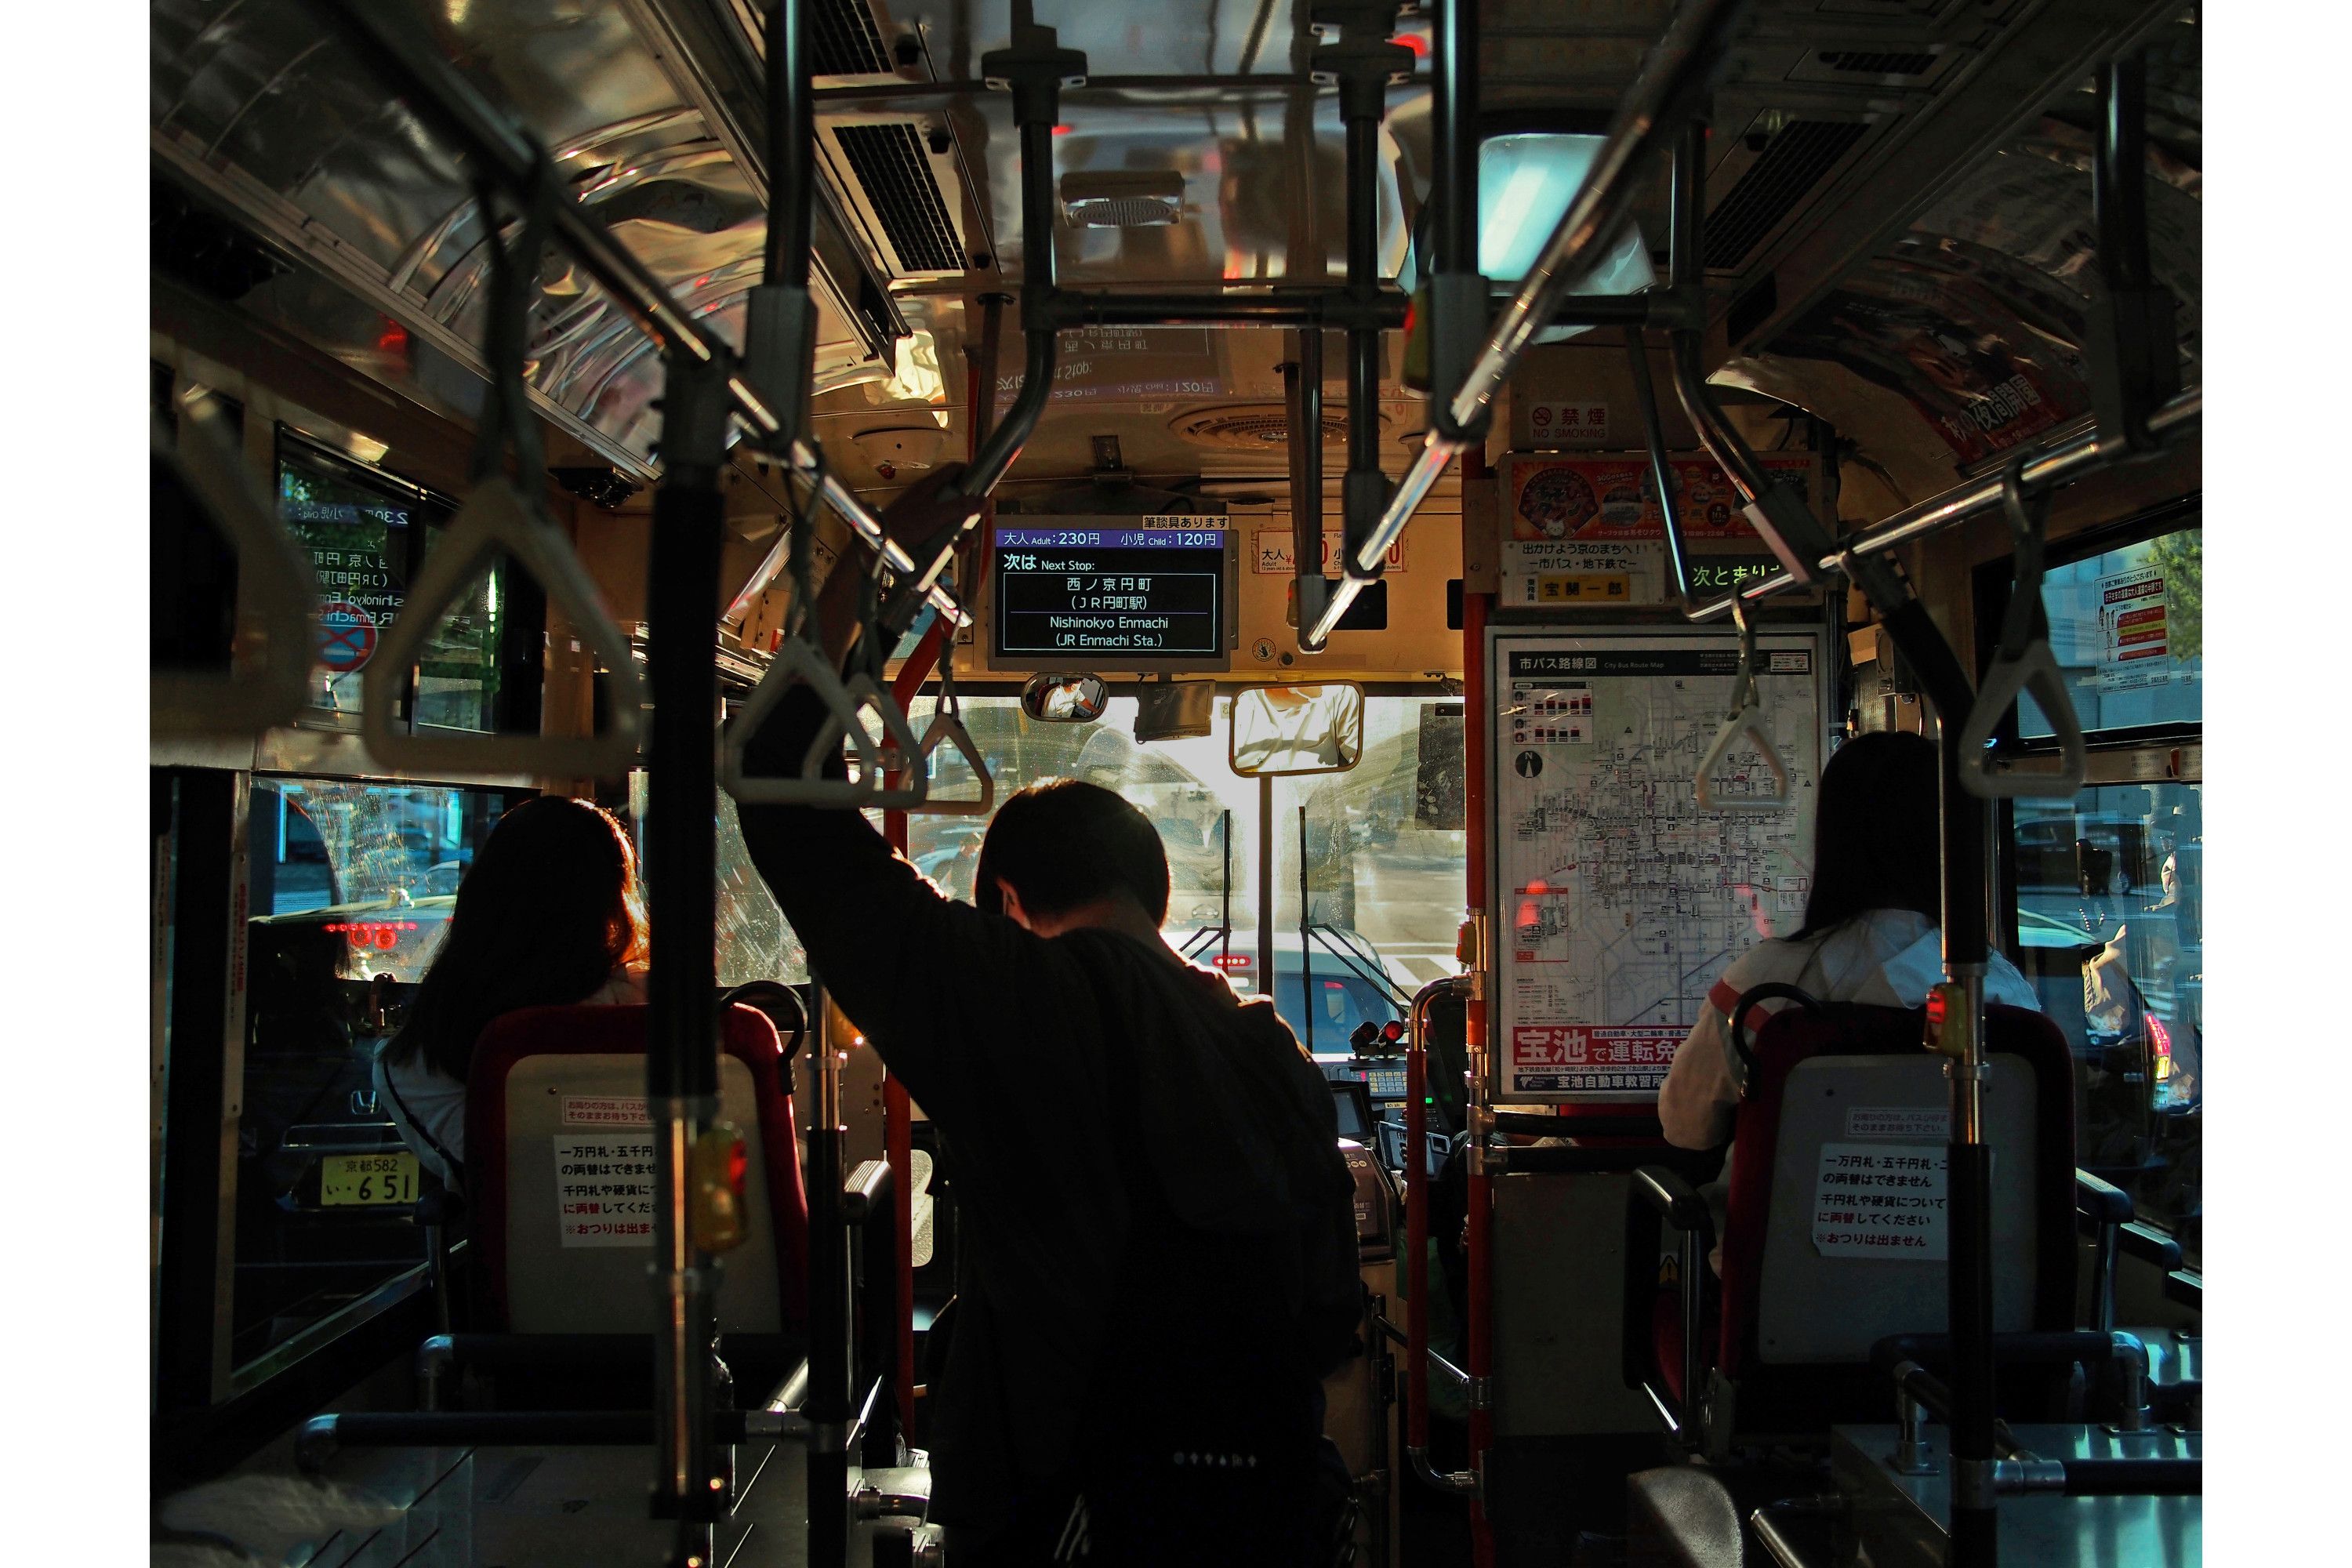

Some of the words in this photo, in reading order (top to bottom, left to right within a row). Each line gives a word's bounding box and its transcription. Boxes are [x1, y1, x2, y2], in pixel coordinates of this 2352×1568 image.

[1562, 408, 1606, 426] 禁煙
[1533, 428, 1549, 438] NO
[1555, 428, 1606, 438] SMOKING
[1144, 517, 1229, 529] 筆談具あります
[1004, 533, 1029, 545] 大人
[1058, 533, 1100, 545] 230円
[1120, 533, 1145, 546] 小児
[1176, 533, 1216, 546] 120円
[1261, 549, 1285, 561] 大人
[1004, 554, 1036, 571] 次は
[1041, 560, 1065, 570] Next
[1069, 560, 1094, 572] Stop:
[1067, 577, 1152, 591] 西ノ京円町
[1071, 596, 1147, 610] (JR円町駅)
[1051, 616, 1115, 630] Nishinokyo
[1119, 616, 1168, 628] Enmachi
[1056, 634, 1076, 647] (JR
[1080, 634, 1130, 647] Enmachi
[1134, 634, 1163, 647] Sta.)
[1519, 657, 1597, 670] 市バス路線図
[1822, 1173, 1933, 1188] の両替はできません
[1820, 1193, 1947, 1210] 千円札や硬貨について
[1817, 1211, 1931, 1226] に両替してください
[1816, 1232, 1927, 1247] ※おつりは出ません
